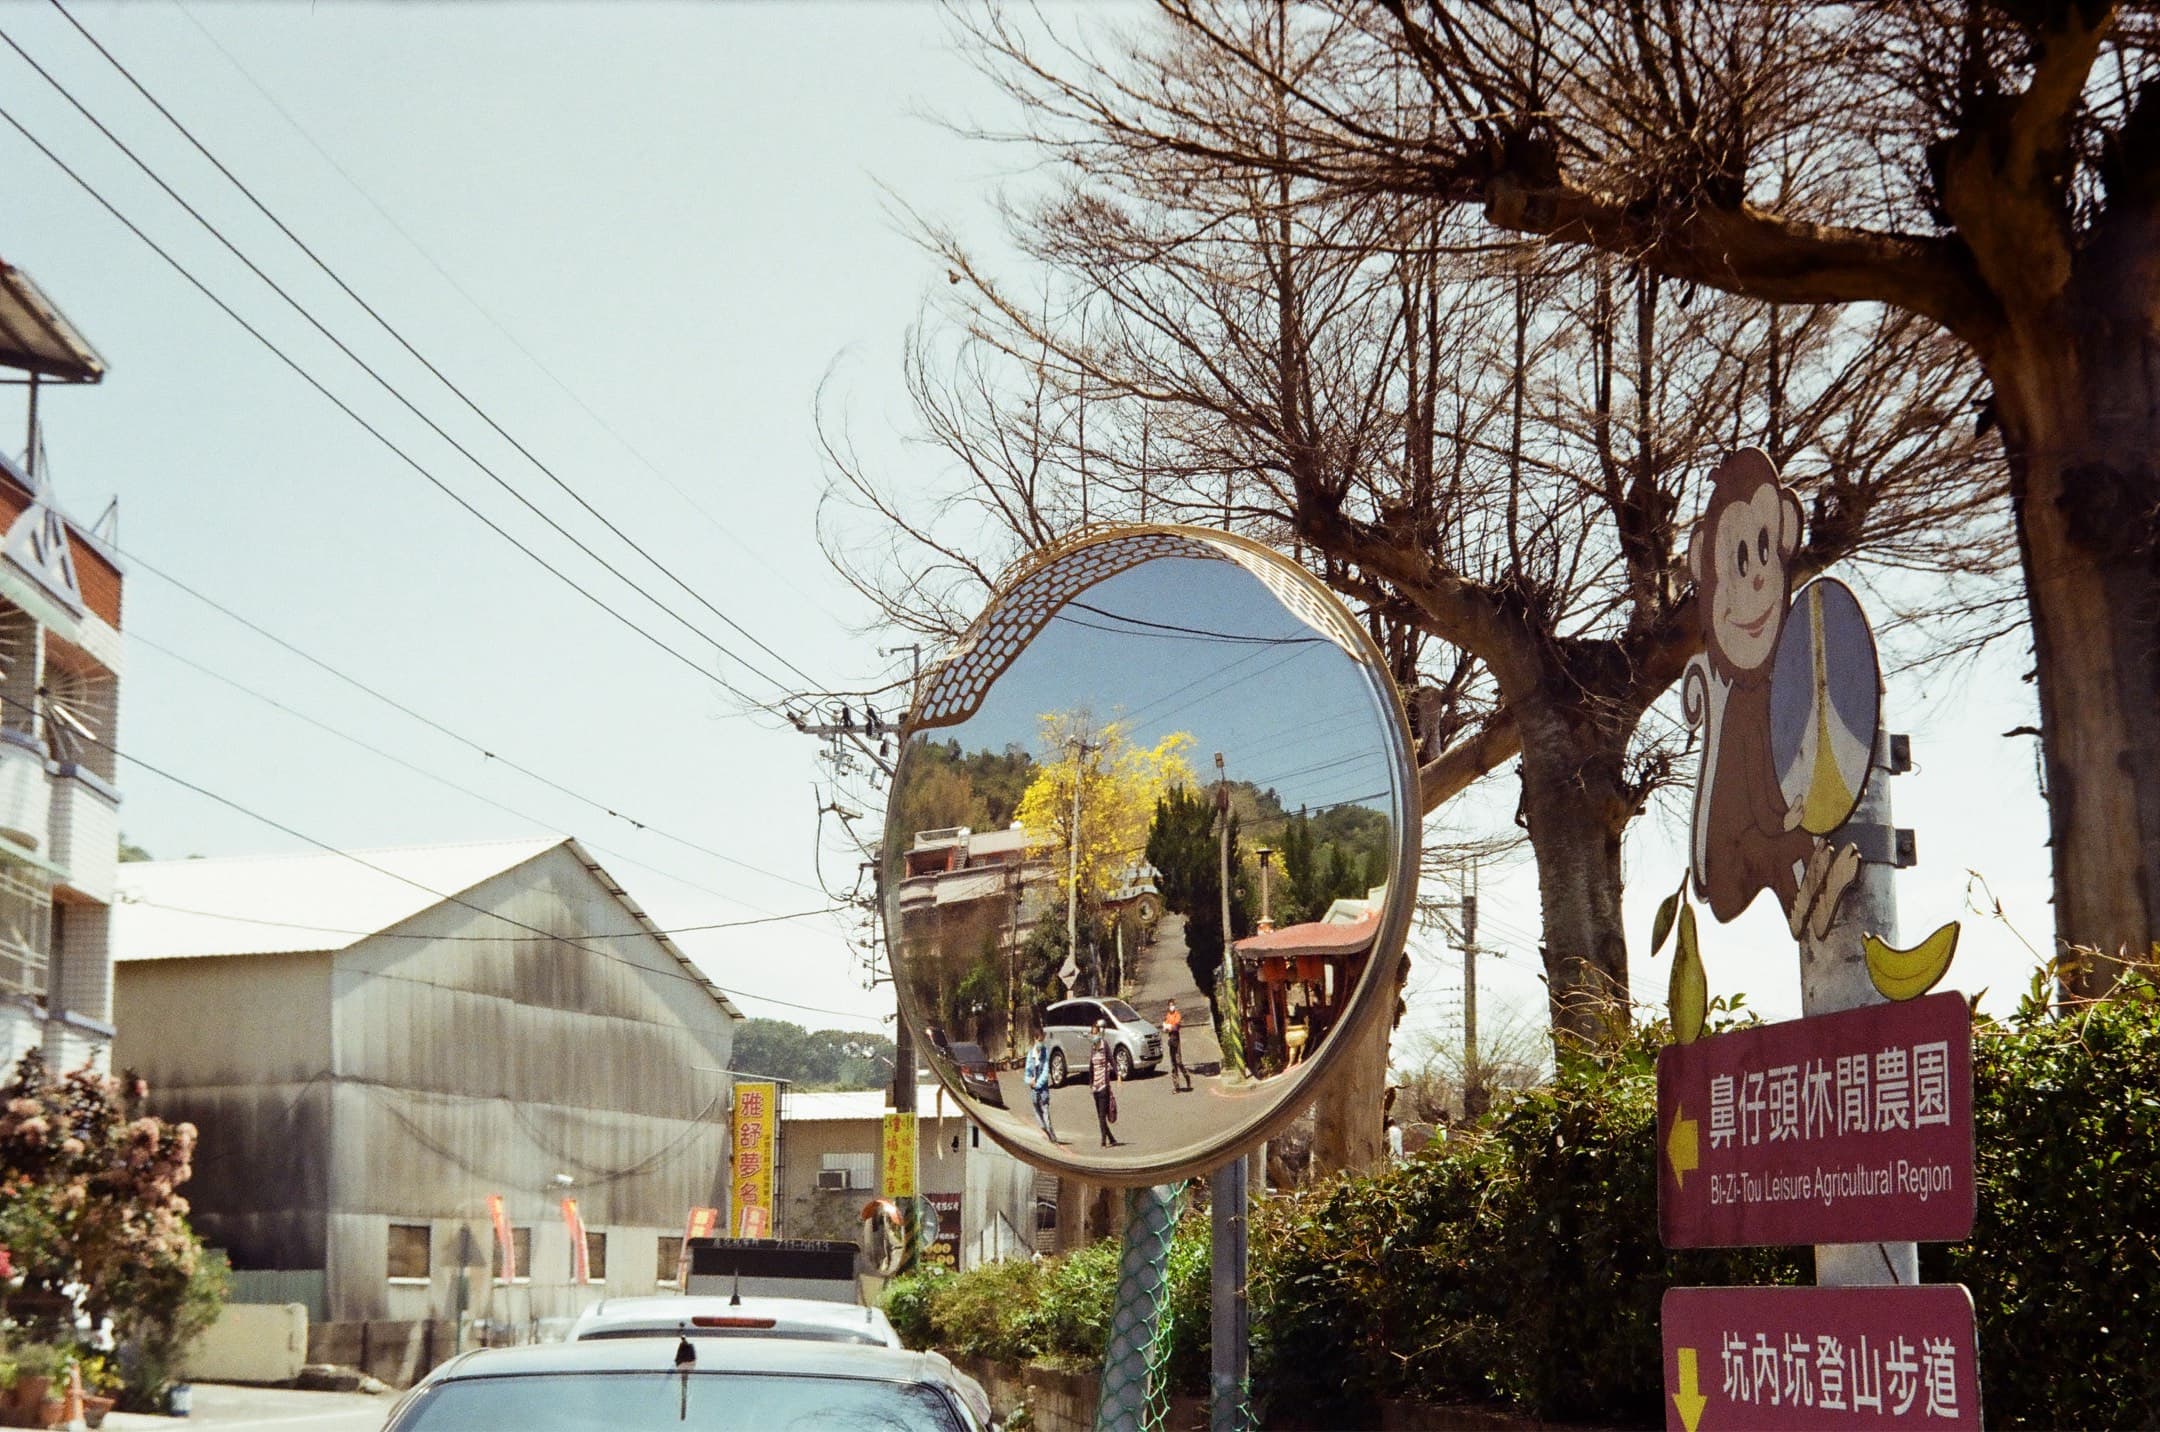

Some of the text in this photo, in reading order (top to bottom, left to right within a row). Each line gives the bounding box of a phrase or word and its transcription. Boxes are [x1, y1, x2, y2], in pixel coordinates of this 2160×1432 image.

[1709, 1041, 1951, 1149] 鼻仔頭休閒農園
[739, 1092, 763, 1226] 雅舒夢名
[1711, 1158, 1952, 1206] Bi-Zi-Tou Leisure Agricultural Region
